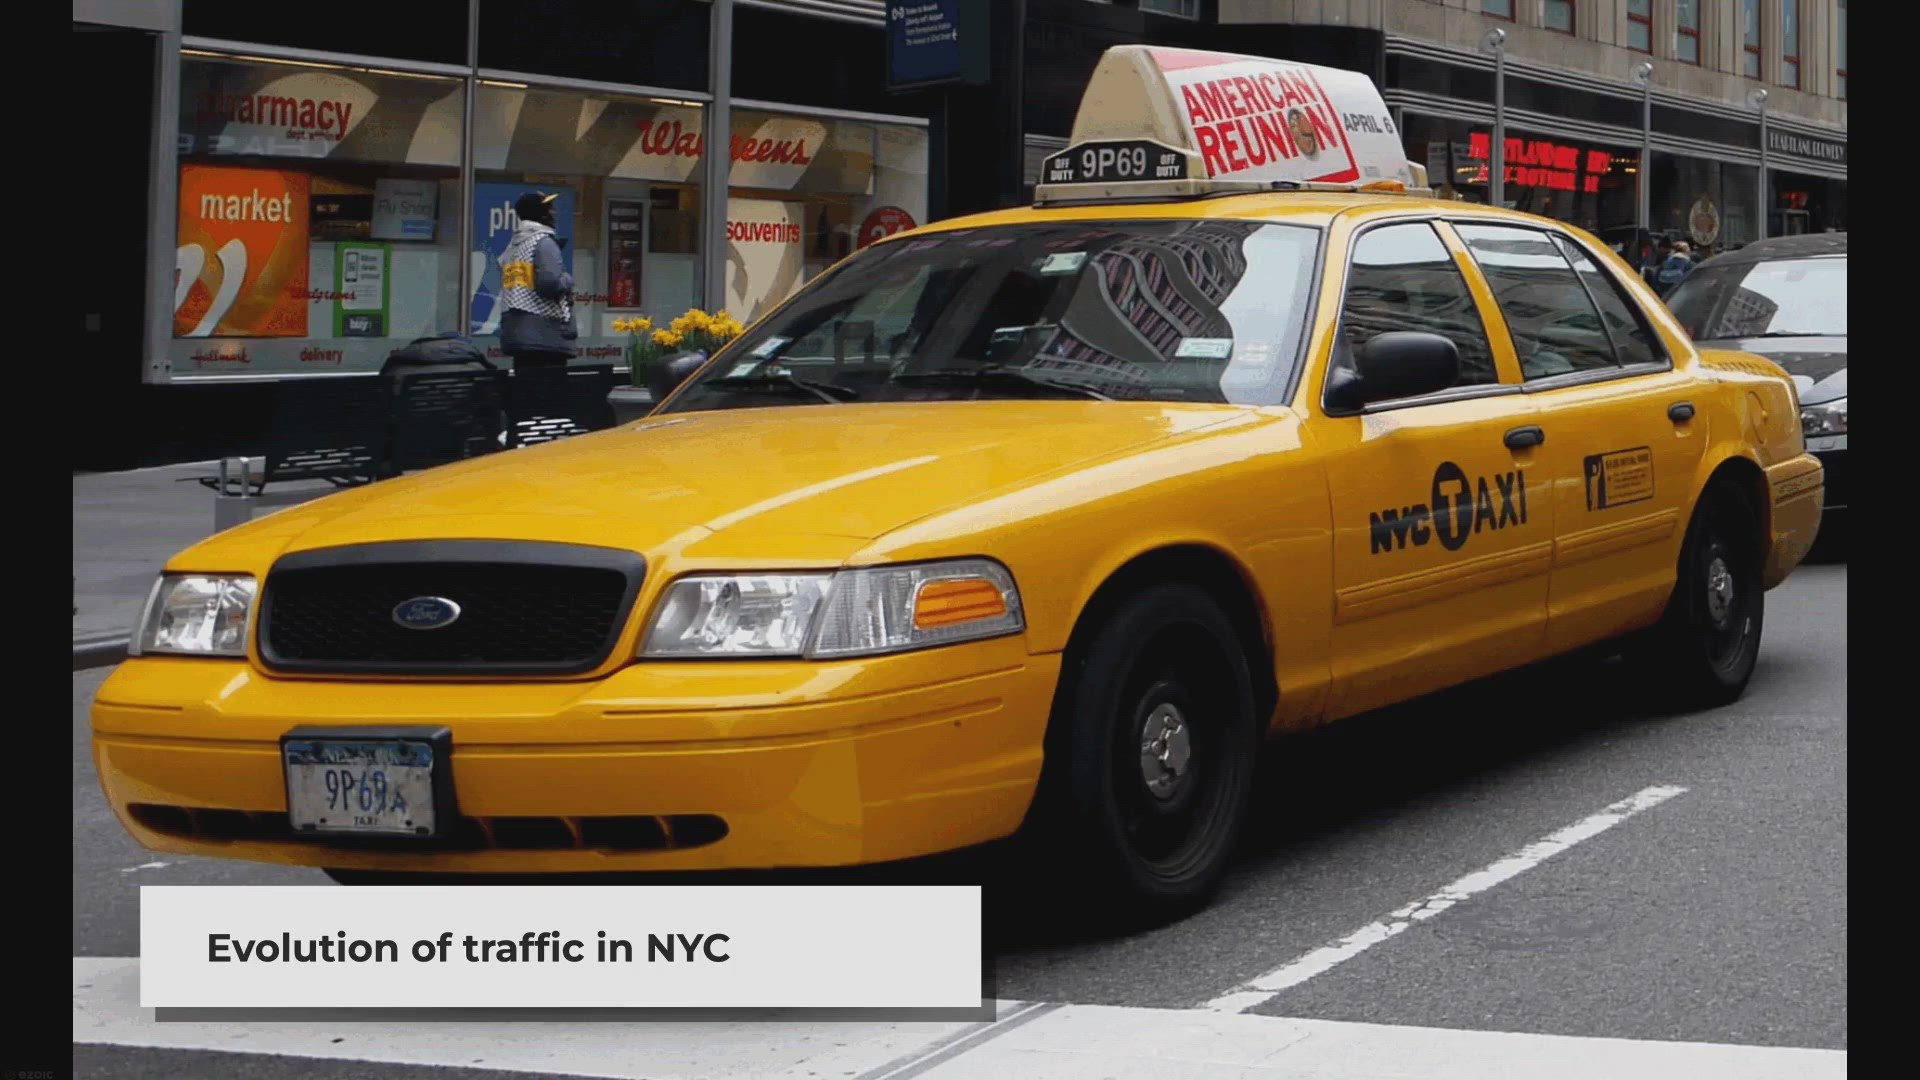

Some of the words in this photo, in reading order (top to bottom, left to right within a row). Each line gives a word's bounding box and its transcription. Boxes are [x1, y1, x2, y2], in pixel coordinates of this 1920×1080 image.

[1181, 69, 1318, 125] AMERICAN
[196, 80, 352, 141] pharmacy
[1343, 112, 1383, 133] APRIL
[1385, 117, 1394, 134] 6
[1054, 158, 1070, 169] OFF
[1082, 147, 1147, 178] 9P69
[1156, 165, 1180, 177] DUTY
[1160, 154, 1176, 165] OFF
[1050, 169, 1074, 181] DUTY
[200, 189, 292, 223] market
[727, 216, 801, 244] souvenirs
[300, 347, 343, 365] delivery
[1369, 503, 1431, 555] NYC
